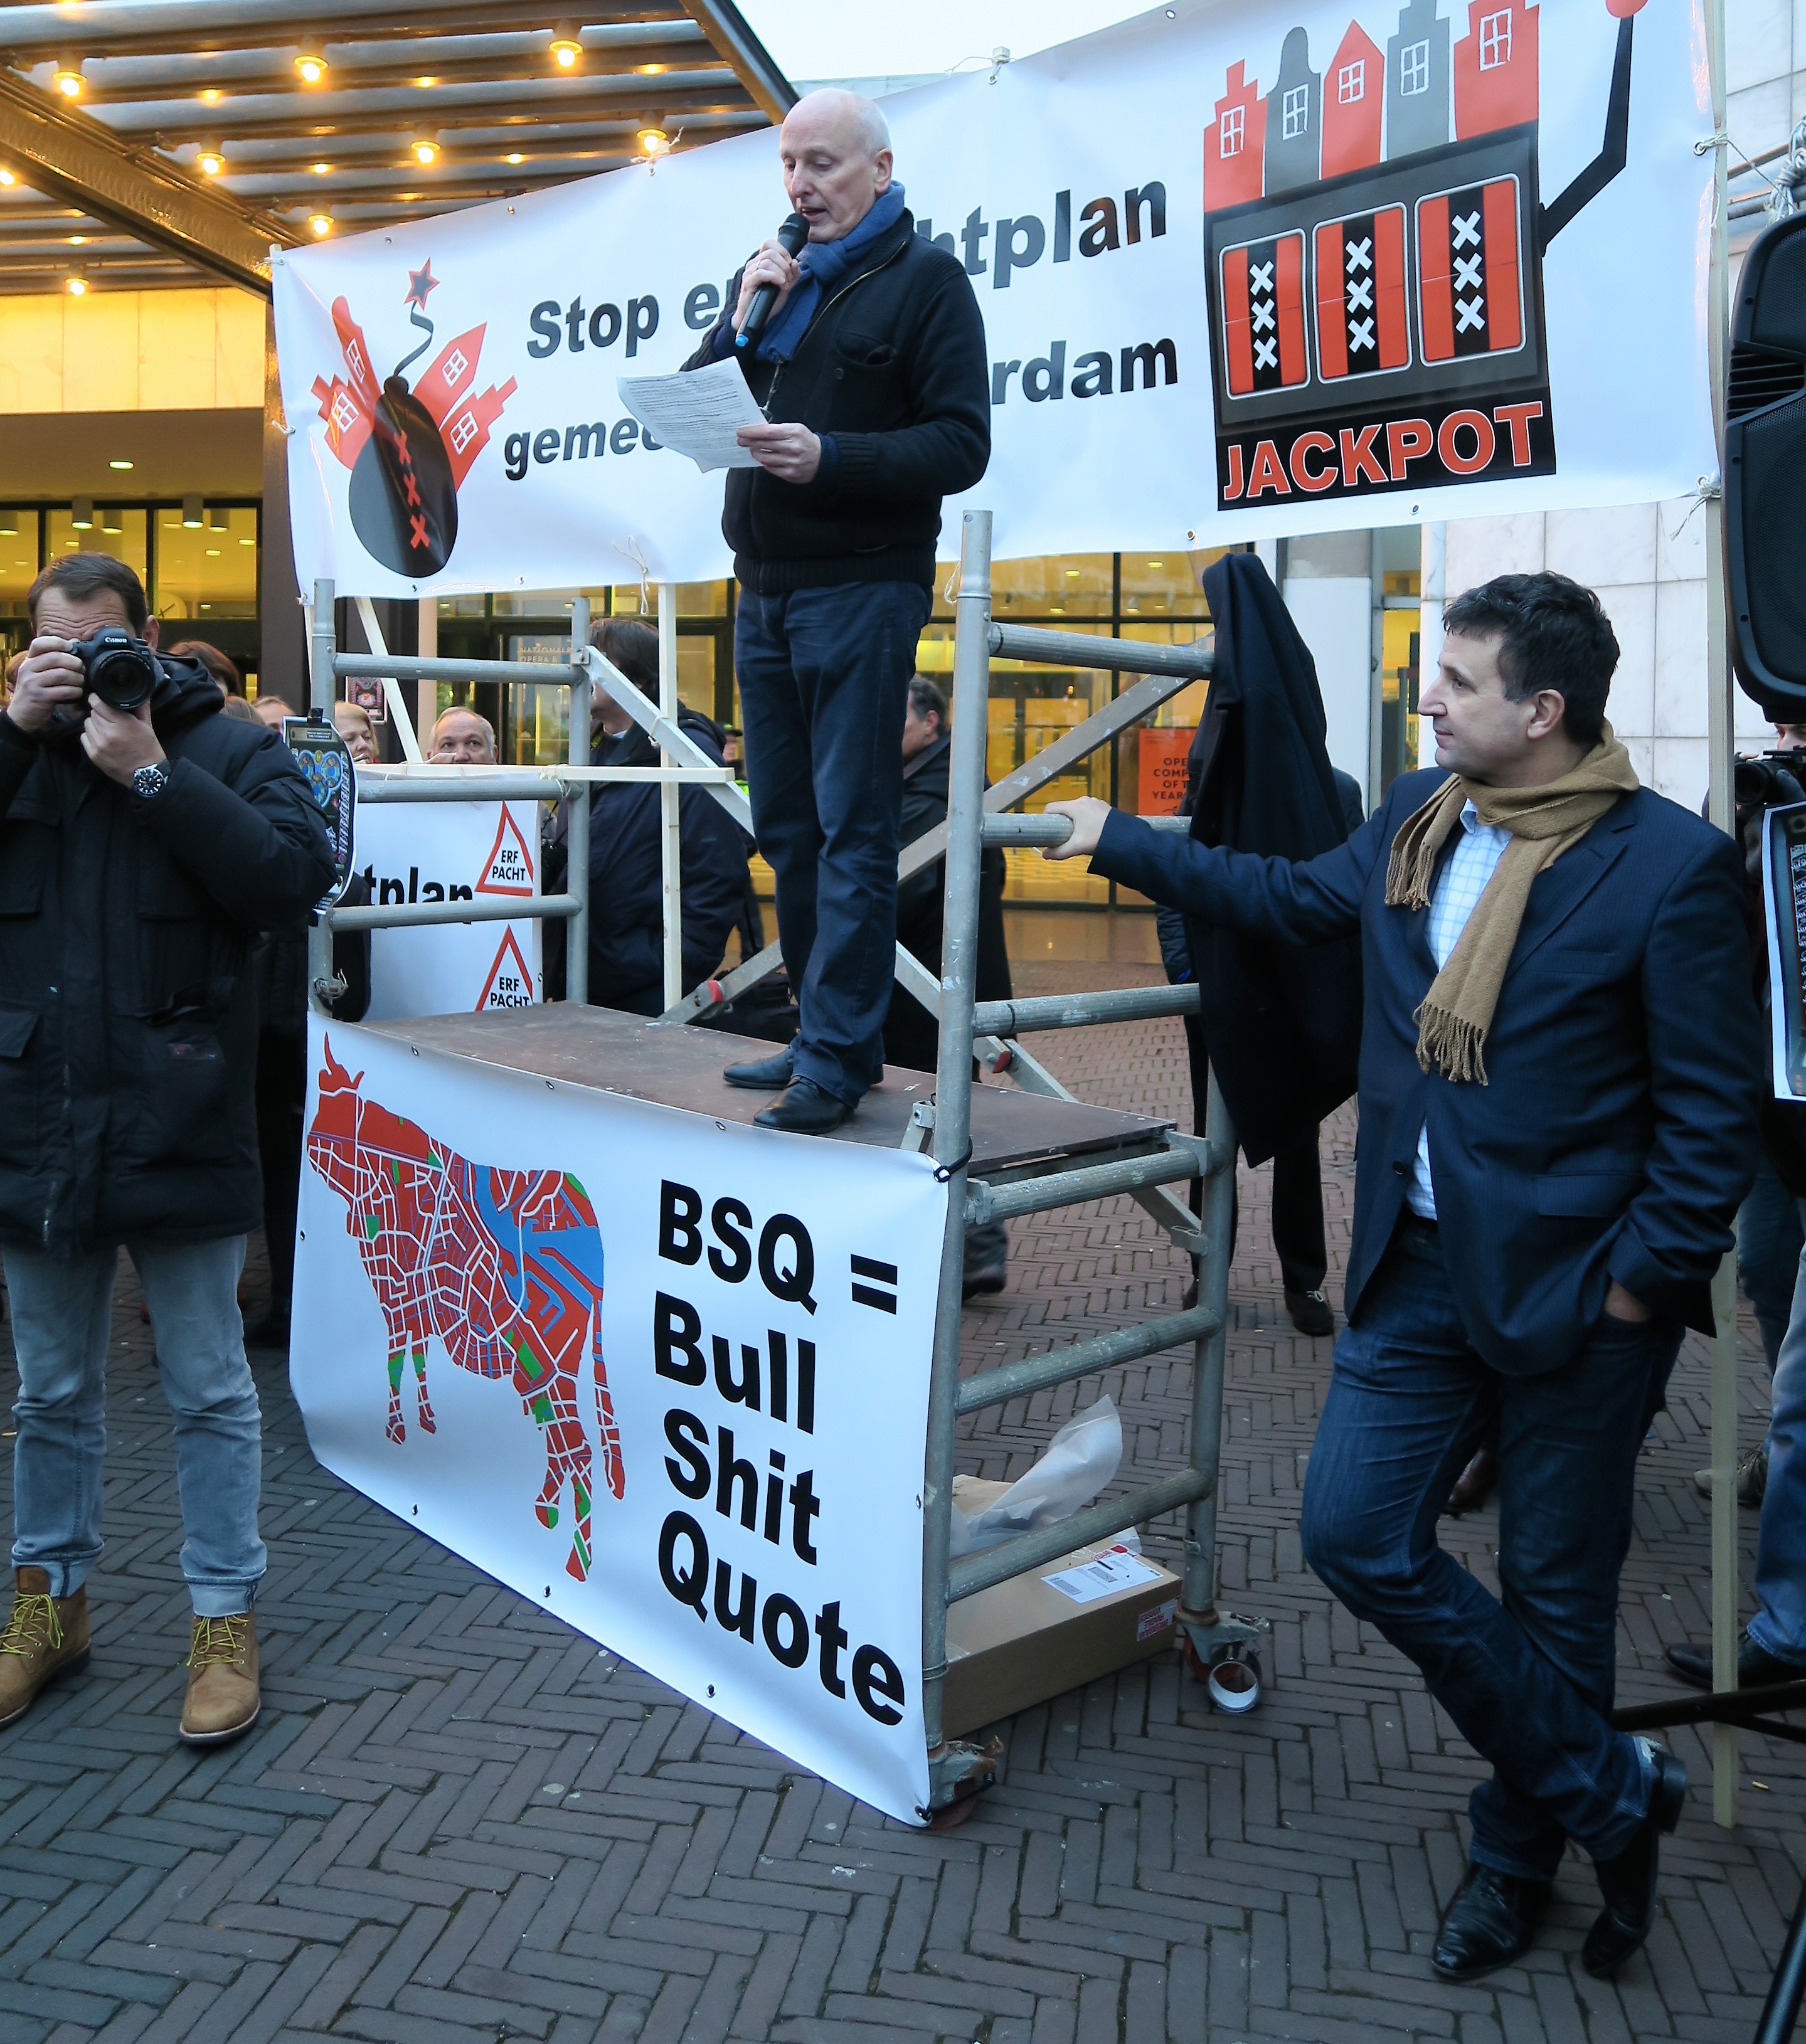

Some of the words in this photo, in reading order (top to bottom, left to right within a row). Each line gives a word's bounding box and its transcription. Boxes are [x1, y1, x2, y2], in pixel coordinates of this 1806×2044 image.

[527, 294, 659, 357] Stop
[1223, 401, 1543, 501] JACKPOT
[1164, 758, 1187, 766] OPE
[1154, 769, 1188, 777] COMP
[1163, 780, 1179, 788] OF
[501, 850, 518, 864] ERF
[492, 866, 526, 881] PACHT
[499, 977, 519, 992] ERF
[490, 992, 529, 1007] PACHT
[659, 1179, 817, 1316] BSQ
[654, 1290, 815, 1435] Bull
[664, 1408, 821, 1565] Shit
[659, 1510, 905, 1726] Quote
